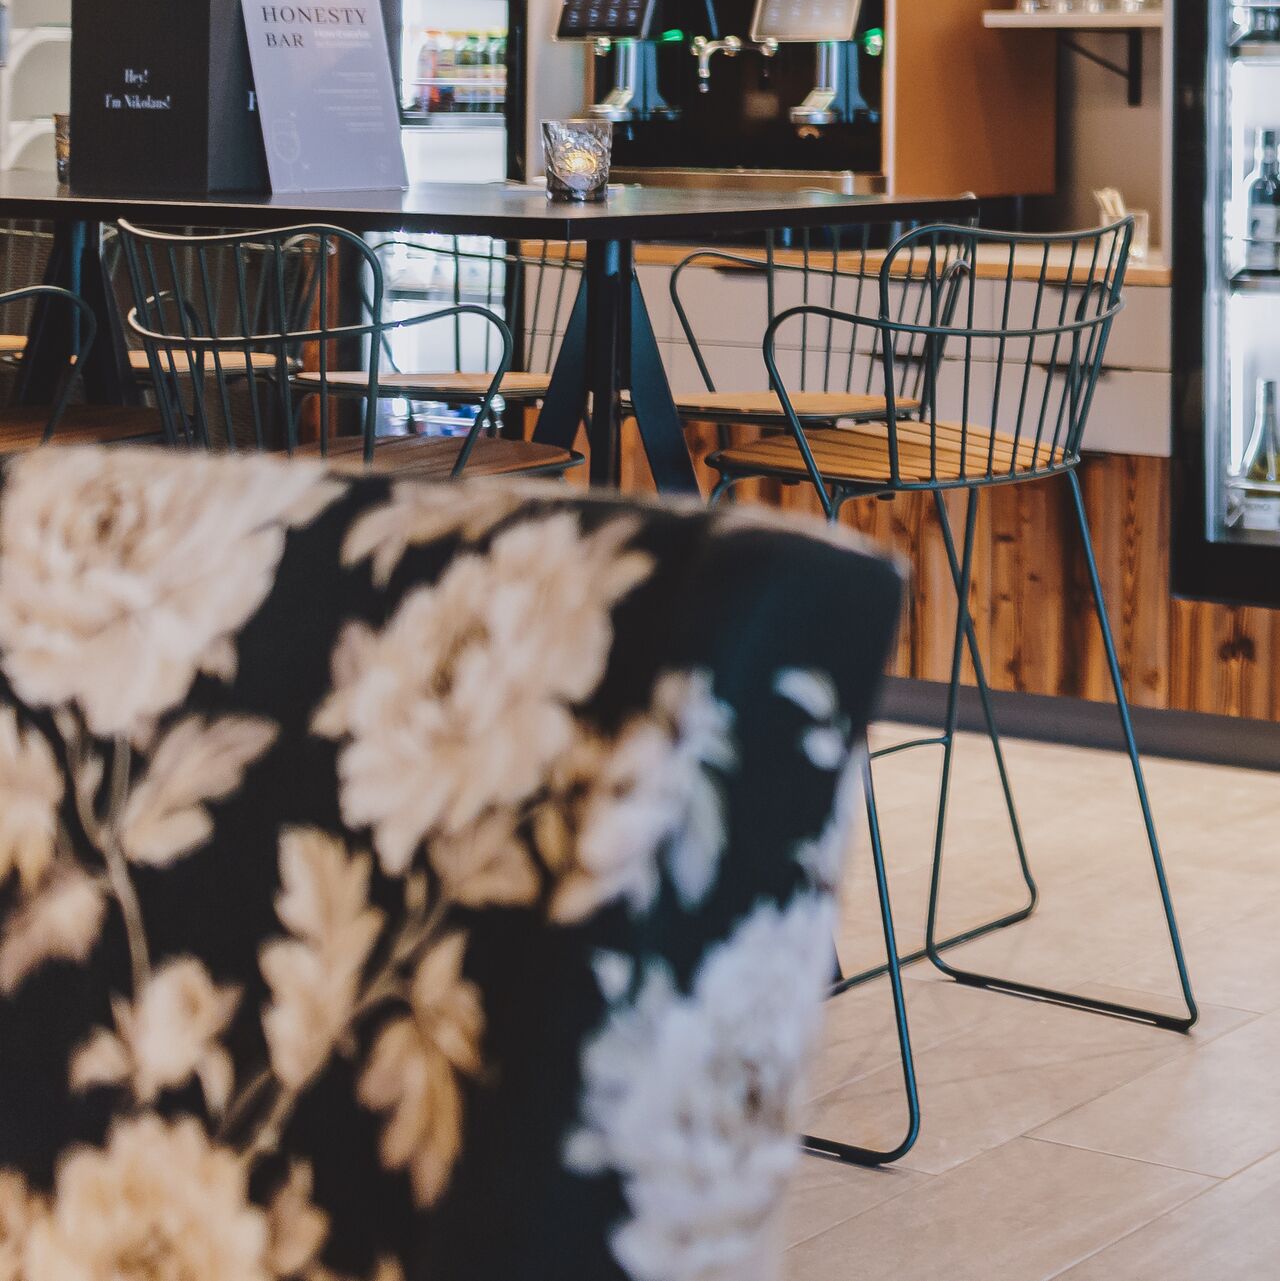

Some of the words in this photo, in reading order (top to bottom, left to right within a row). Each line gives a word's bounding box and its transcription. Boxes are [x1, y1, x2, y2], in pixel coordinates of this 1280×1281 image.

[261, 5, 368, 25] HONESTY
[265, 31, 305, 48] BAR
[124, 67, 149, 87] Hey!
[104, 93, 121, 108] I'm
[124, 94, 172, 110] Nikolaus!
